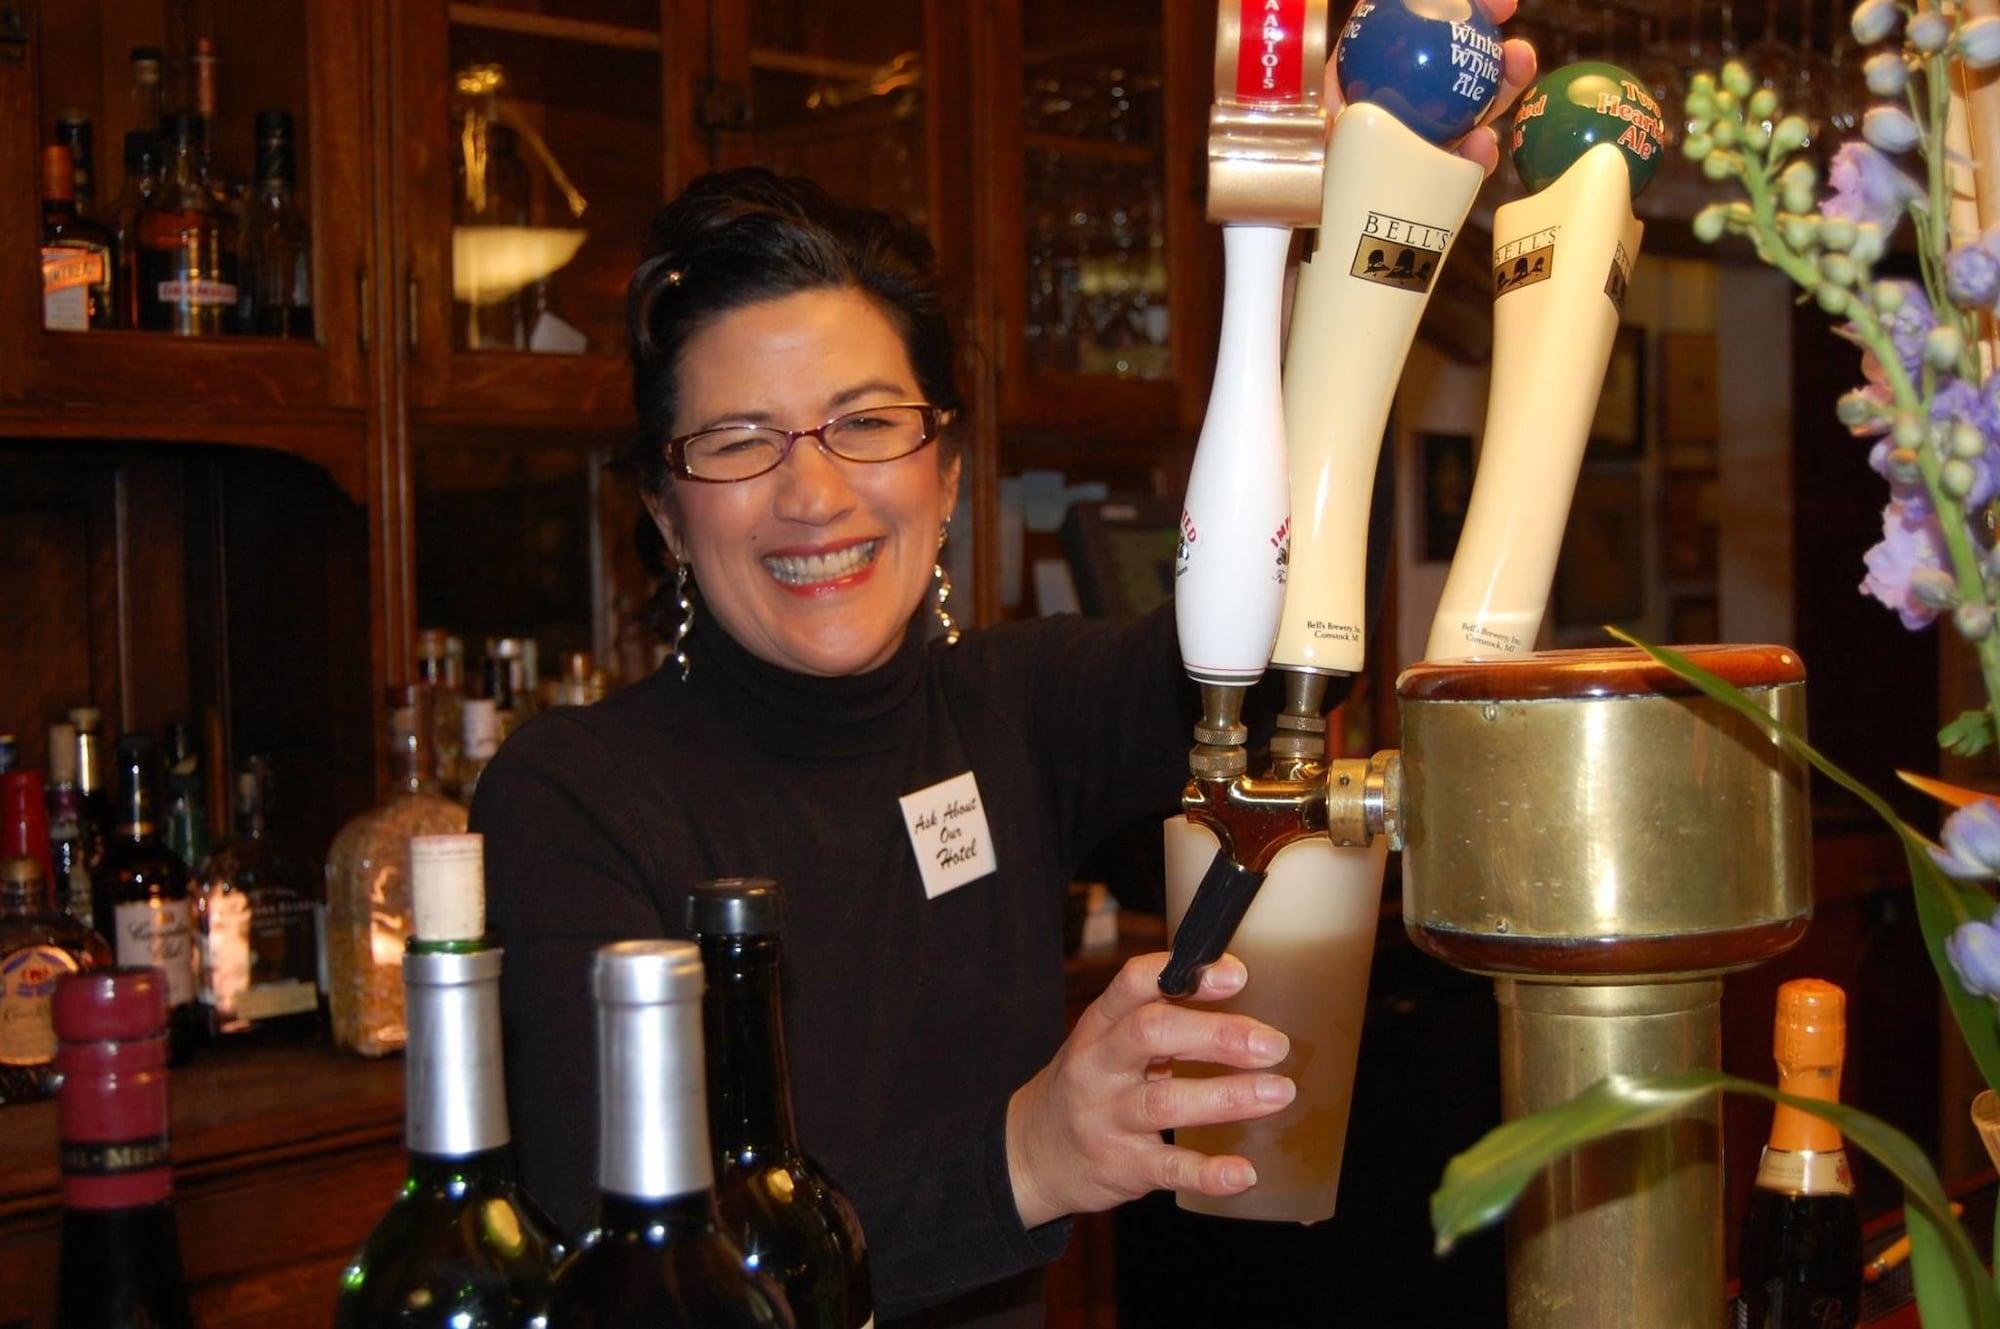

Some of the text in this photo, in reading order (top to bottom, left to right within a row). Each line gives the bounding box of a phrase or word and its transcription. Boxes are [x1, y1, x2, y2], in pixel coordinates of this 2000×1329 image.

[1449, 20, 1503, 61] Winter
[1450, 43, 1500, 84] White
[1452, 72, 1485, 101] Ale
[1621, 80, 1661, 118] Two
[1617, 125, 1653, 160] Ale
[1363, 214, 1449, 251] BELL'S
[915, 797, 977, 835] Ask About
[935, 837, 977, 870] Hotel
[939, 826, 962, 844] Our
